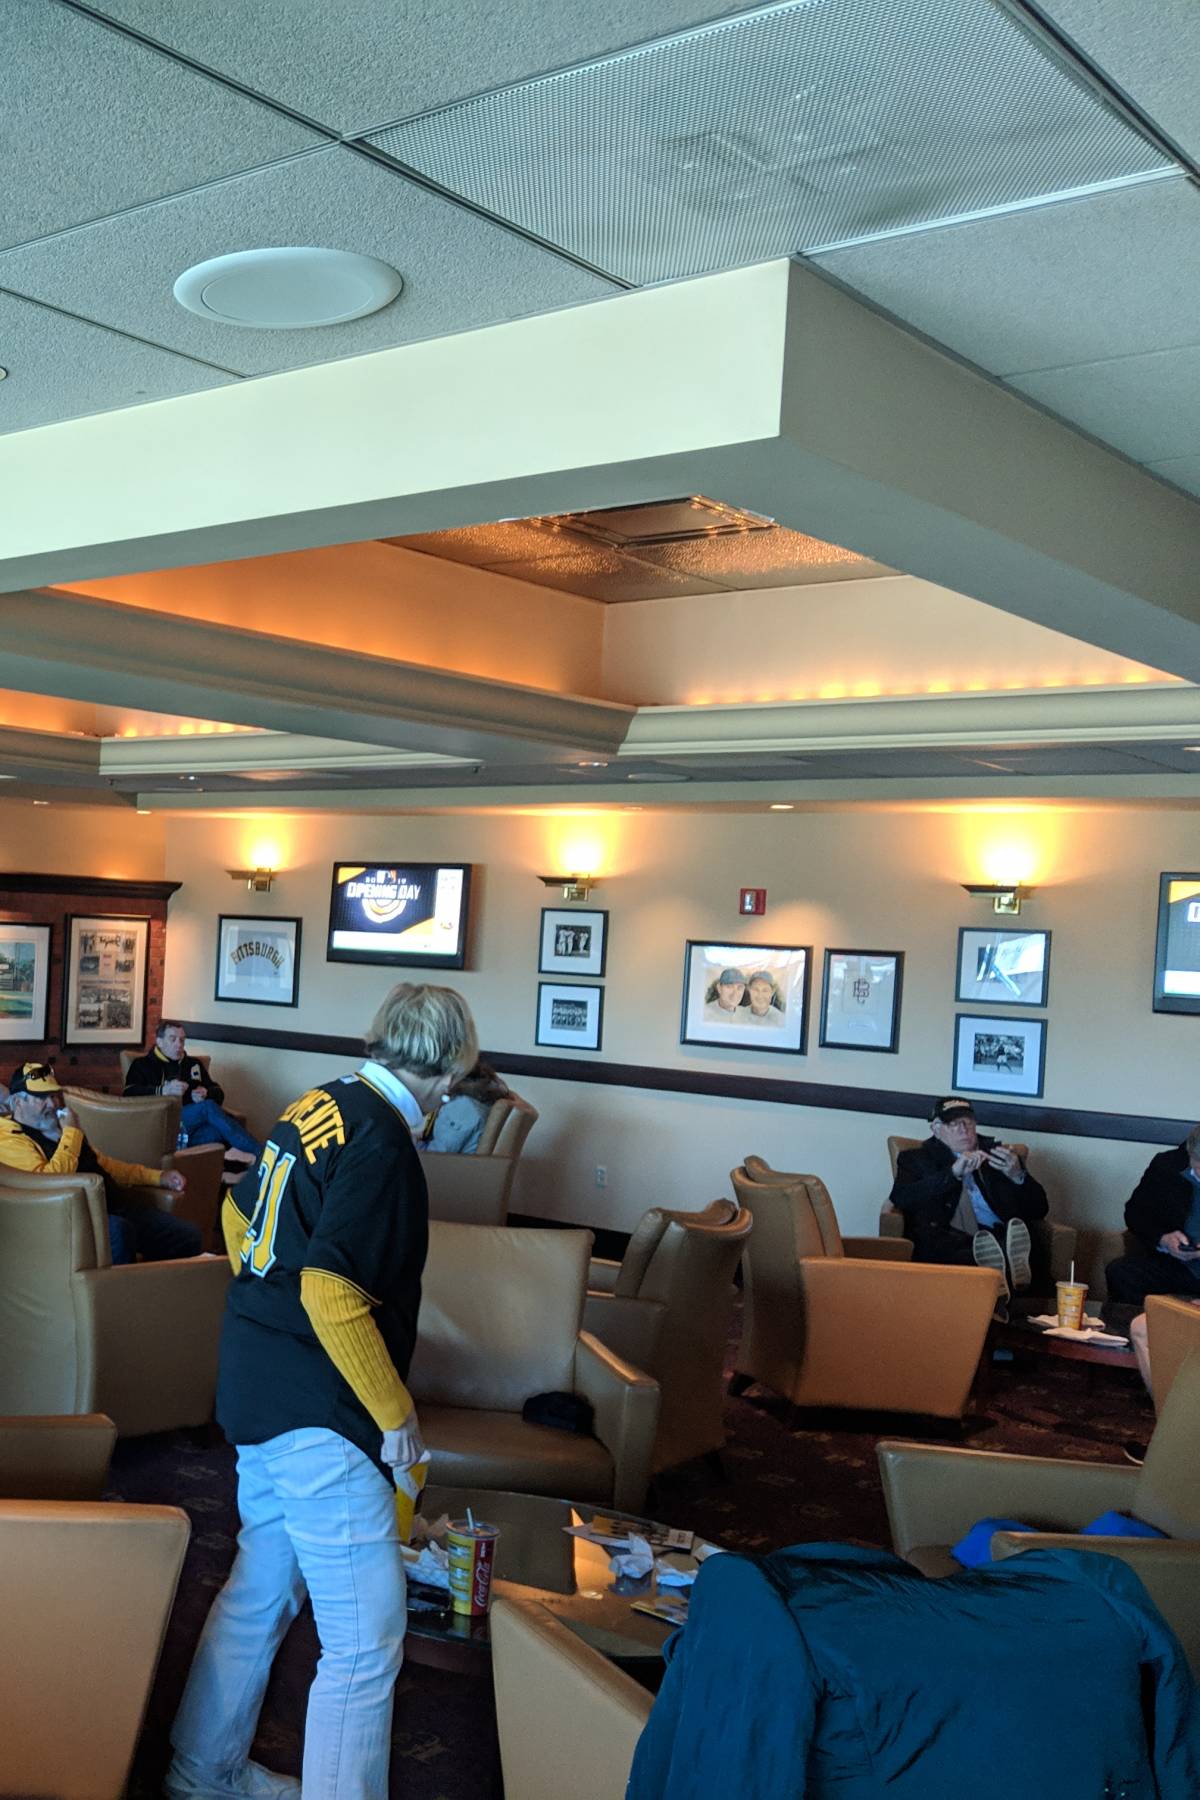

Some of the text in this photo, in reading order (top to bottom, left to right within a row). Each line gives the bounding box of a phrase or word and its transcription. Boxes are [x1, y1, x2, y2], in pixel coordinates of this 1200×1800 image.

[346, 882, 421, 900] OPENING DAY
[230, 941, 285, 969] PITTSBURGH
